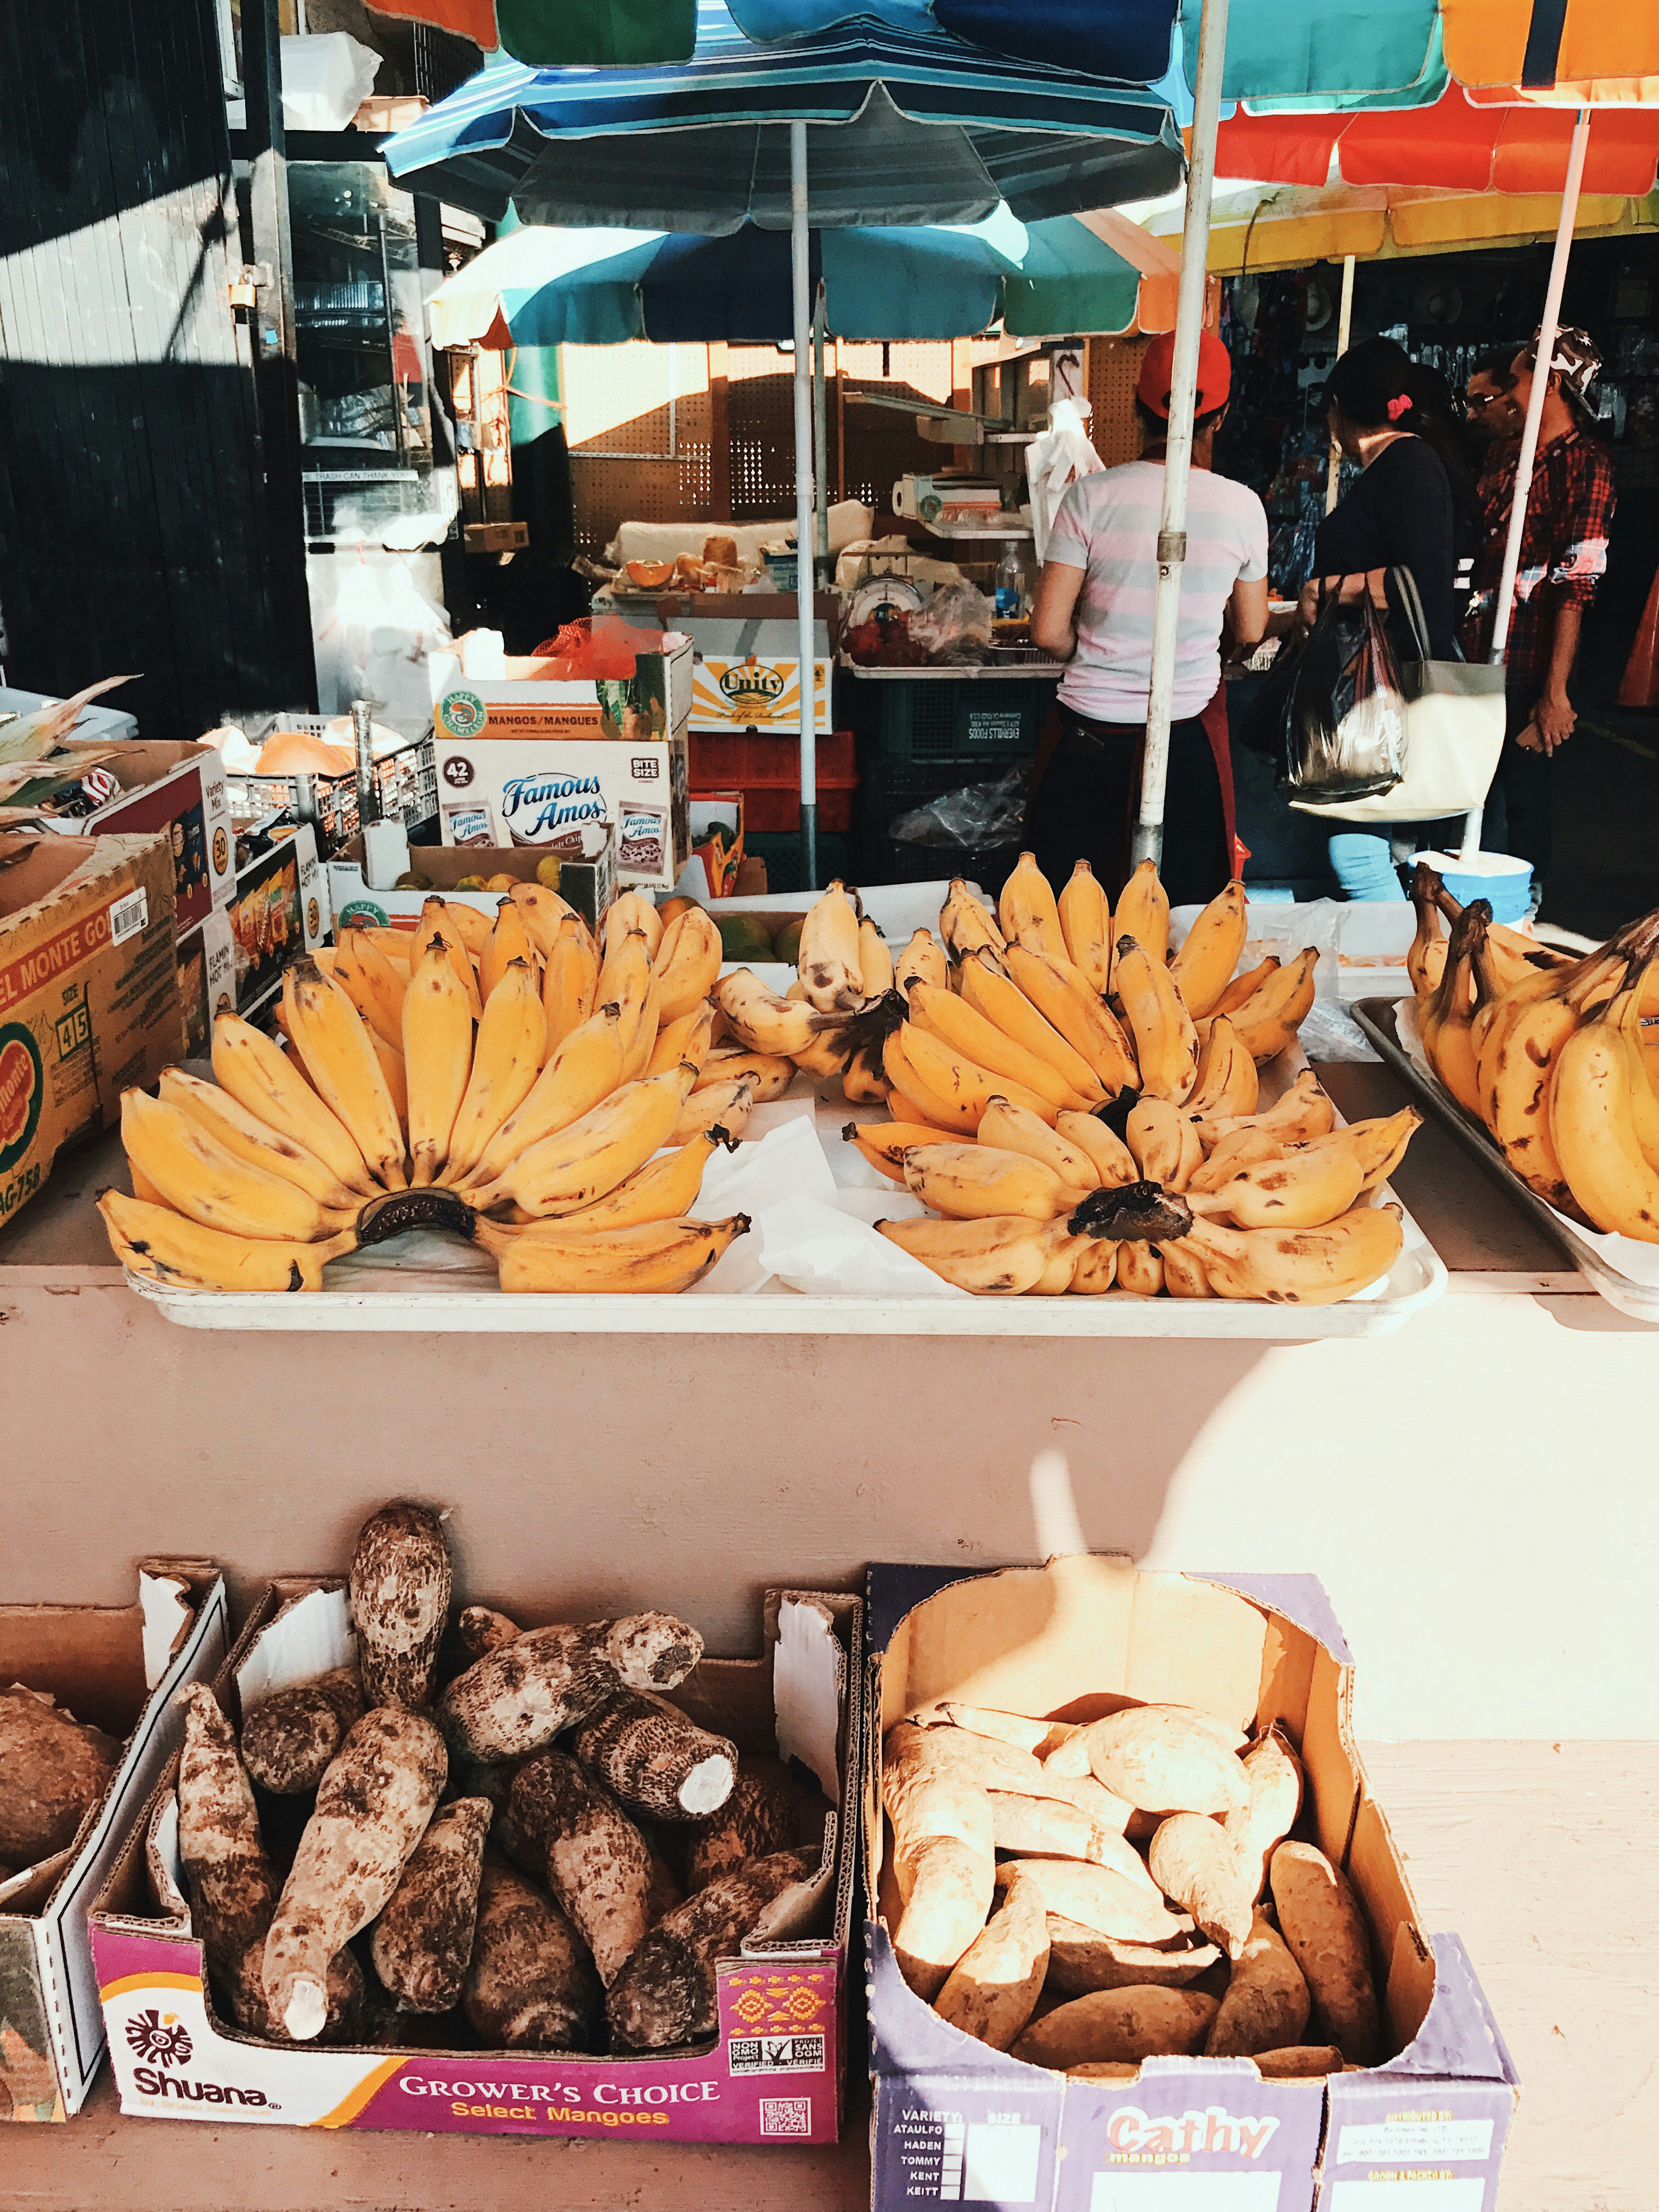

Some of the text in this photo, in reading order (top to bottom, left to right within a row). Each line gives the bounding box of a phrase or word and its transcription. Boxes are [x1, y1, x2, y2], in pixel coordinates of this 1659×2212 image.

[362, 472, 389, 480] THANK
[725, 672, 780, 693] Unity
[968, 728, 988, 738] FOODS
[447, 762, 469, 777] 42
[633, 759, 657, 768] BITE
[633, 769, 658, 777] SIZE
[502, 776, 600, 817] Famous
[449, 811, 486, 832] Famous
[525, 800, 606, 836] Amos
[620, 814, 661, 829] Famous
[460, 822, 488, 838] Amos
[629, 826, 659, 837] Amos
[216, 836, 225, 860] 30
[346, 904, 380, 915] HAPPY
[20, 930, 81, 990] MONTE
[210, 965, 221, 986] HOT
[733, 2061, 774, 2069] VERIFIED
[133, 2067, 267, 2106] Shuana
[399, 2076, 720, 2105] GROWER'S CHOICE
[452, 2101, 670, 2126] Select Mangoes
[902, 2109, 962, 2123] VARIETY:
[988, 2113, 1021, 2125] SIZE
[893, 2125, 943, 2135] ATAULFO
[1108, 2109, 1276, 2158] Cathy
[904, 2141, 941, 2151] HADEN
[901, 2156, 941, 2165] TOMMY
[1108, 2153, 1190, 2165] mangos
[910, 2171, 940, 2181] KENT
[906, 2187, 939, 2196] KEITT
